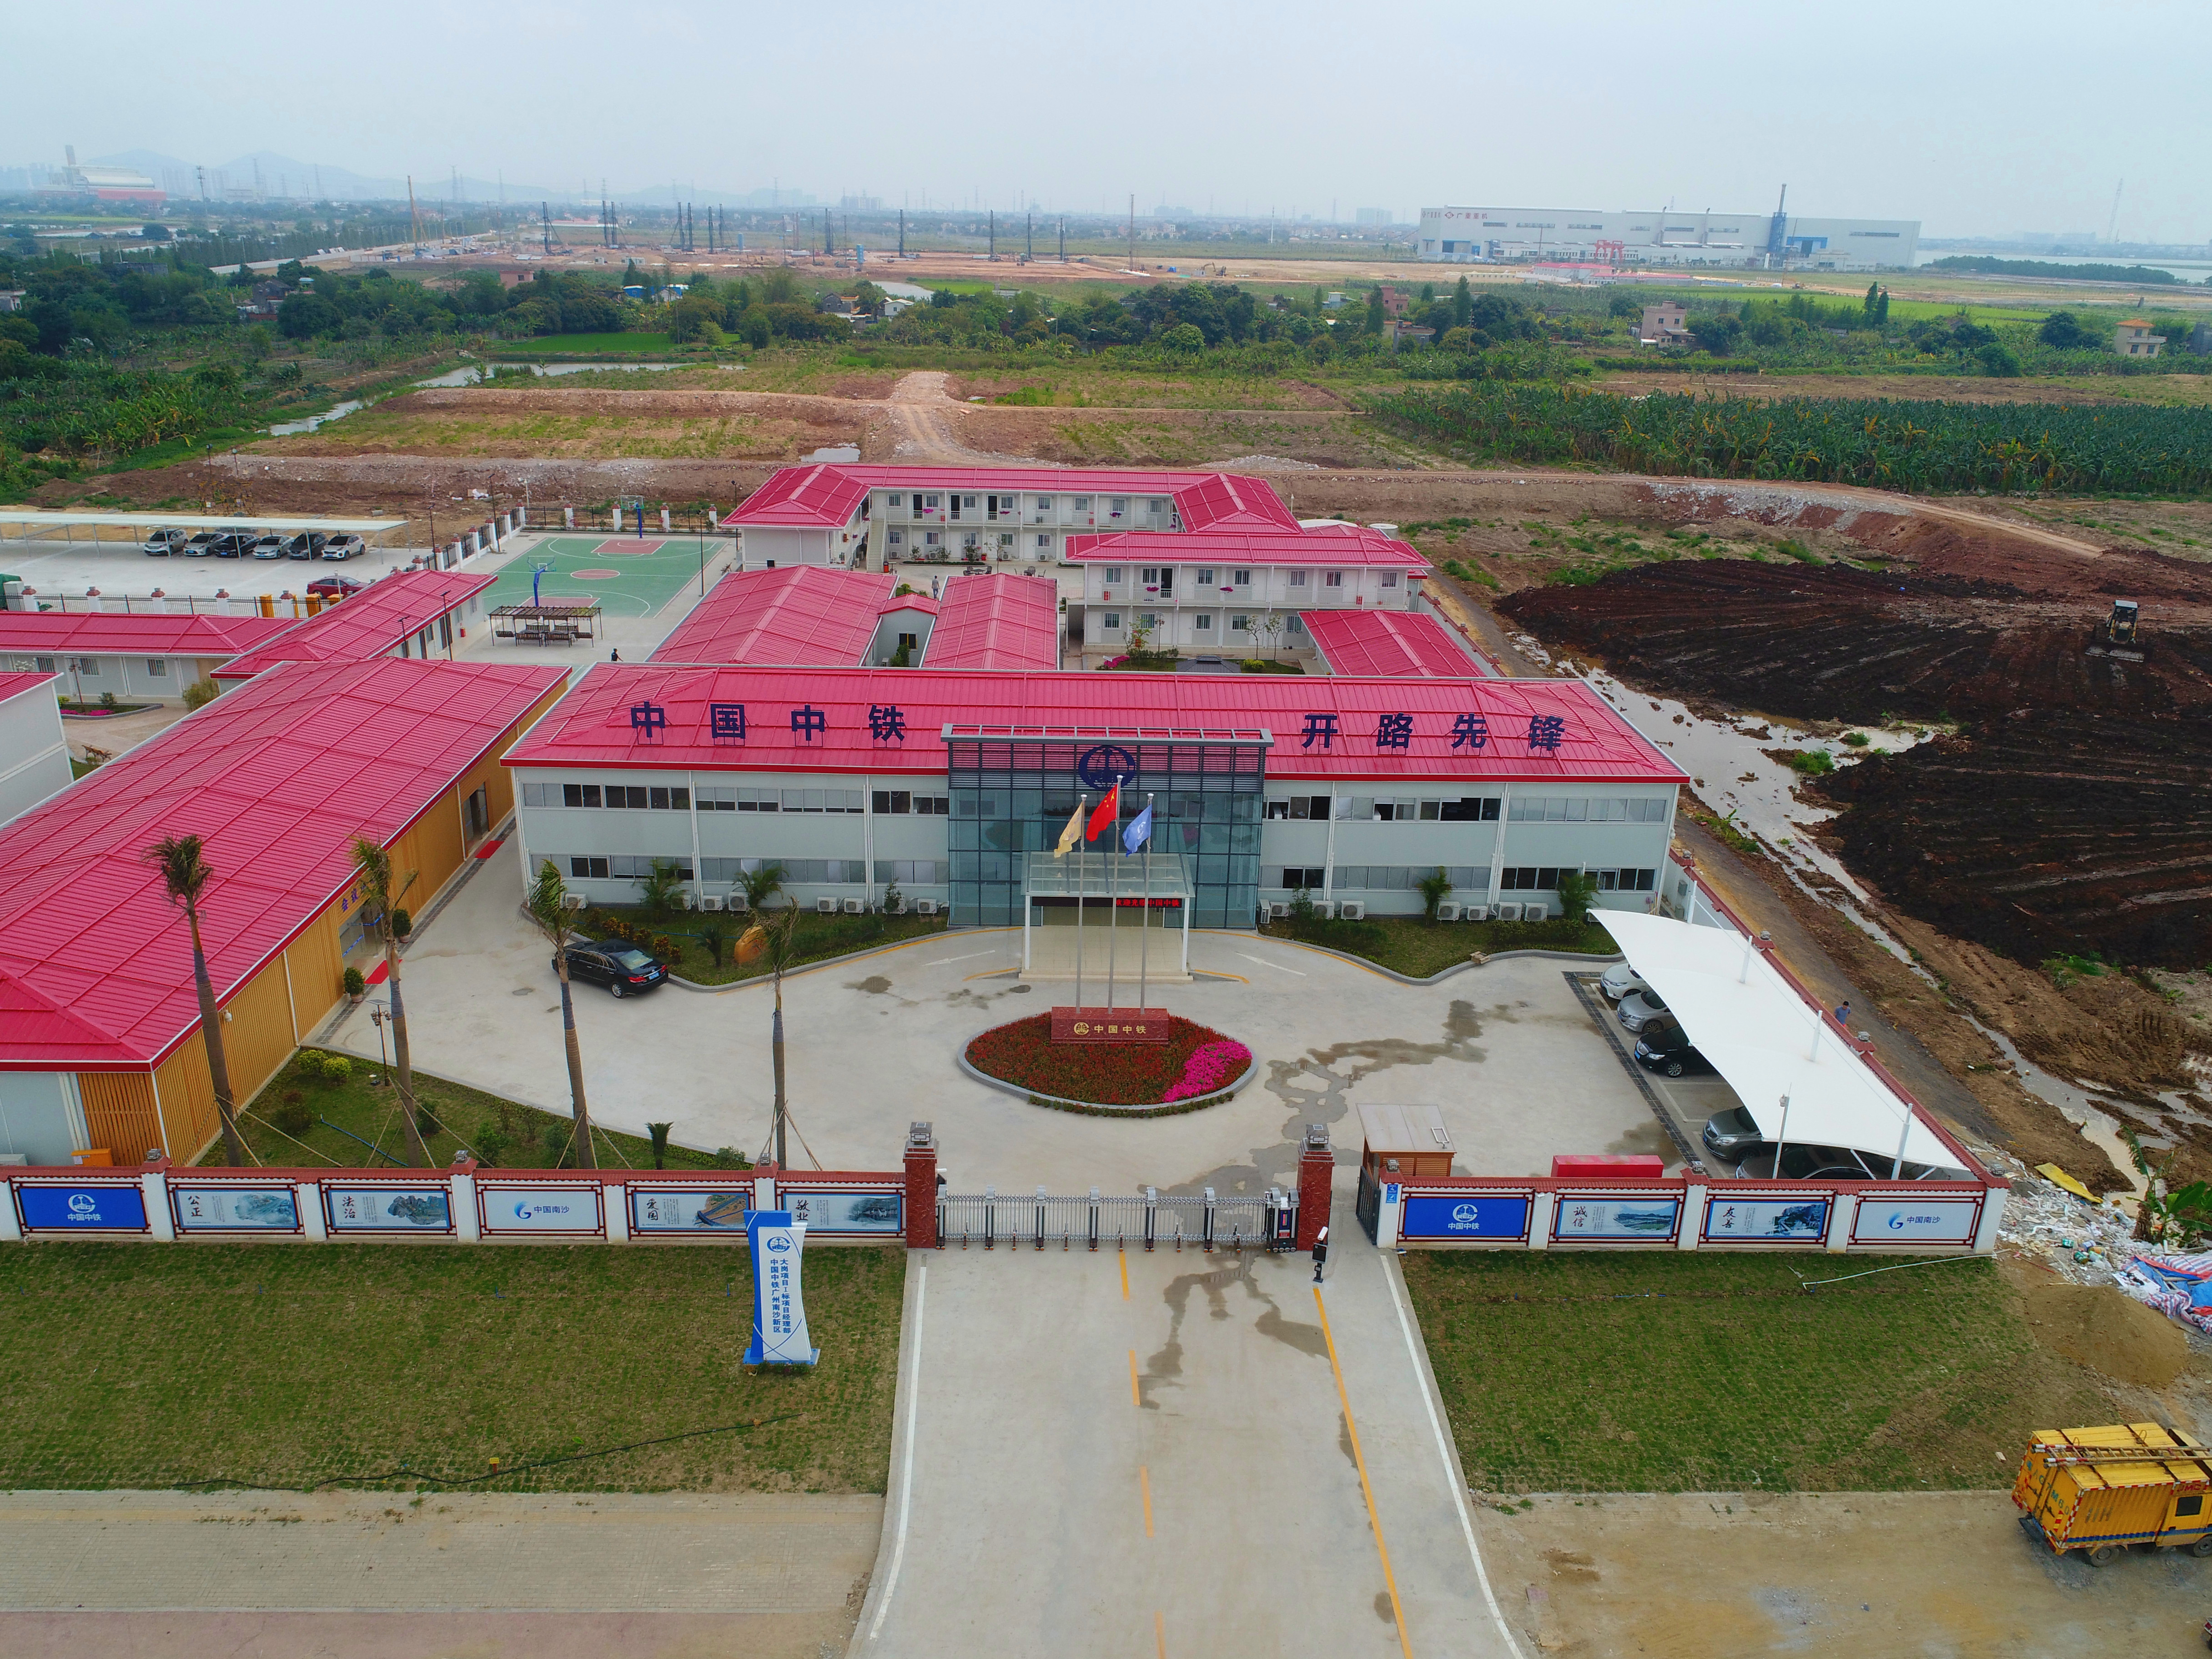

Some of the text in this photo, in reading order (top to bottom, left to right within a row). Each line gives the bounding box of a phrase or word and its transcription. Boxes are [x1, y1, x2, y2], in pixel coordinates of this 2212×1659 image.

[631, 701, 905, 742] 中国中铁
[1302, 713, 1565, 751] 开路先锋
[1094, 1025, 1146, 1035] 中国中铁
[188, 1195, 203, 1217] 公正
[342, 1196, 356, 1219] 法治
[646, 1198, 659, 1221] 爱国
[795, 1199, 810, 1221] 敬业
[1573, 1206, 1588, 1227] 诚信
[1722, 1206, 1736, 1229] 友善
[770, 1258, 781, 1333] 中国中铁广州南沙新区
